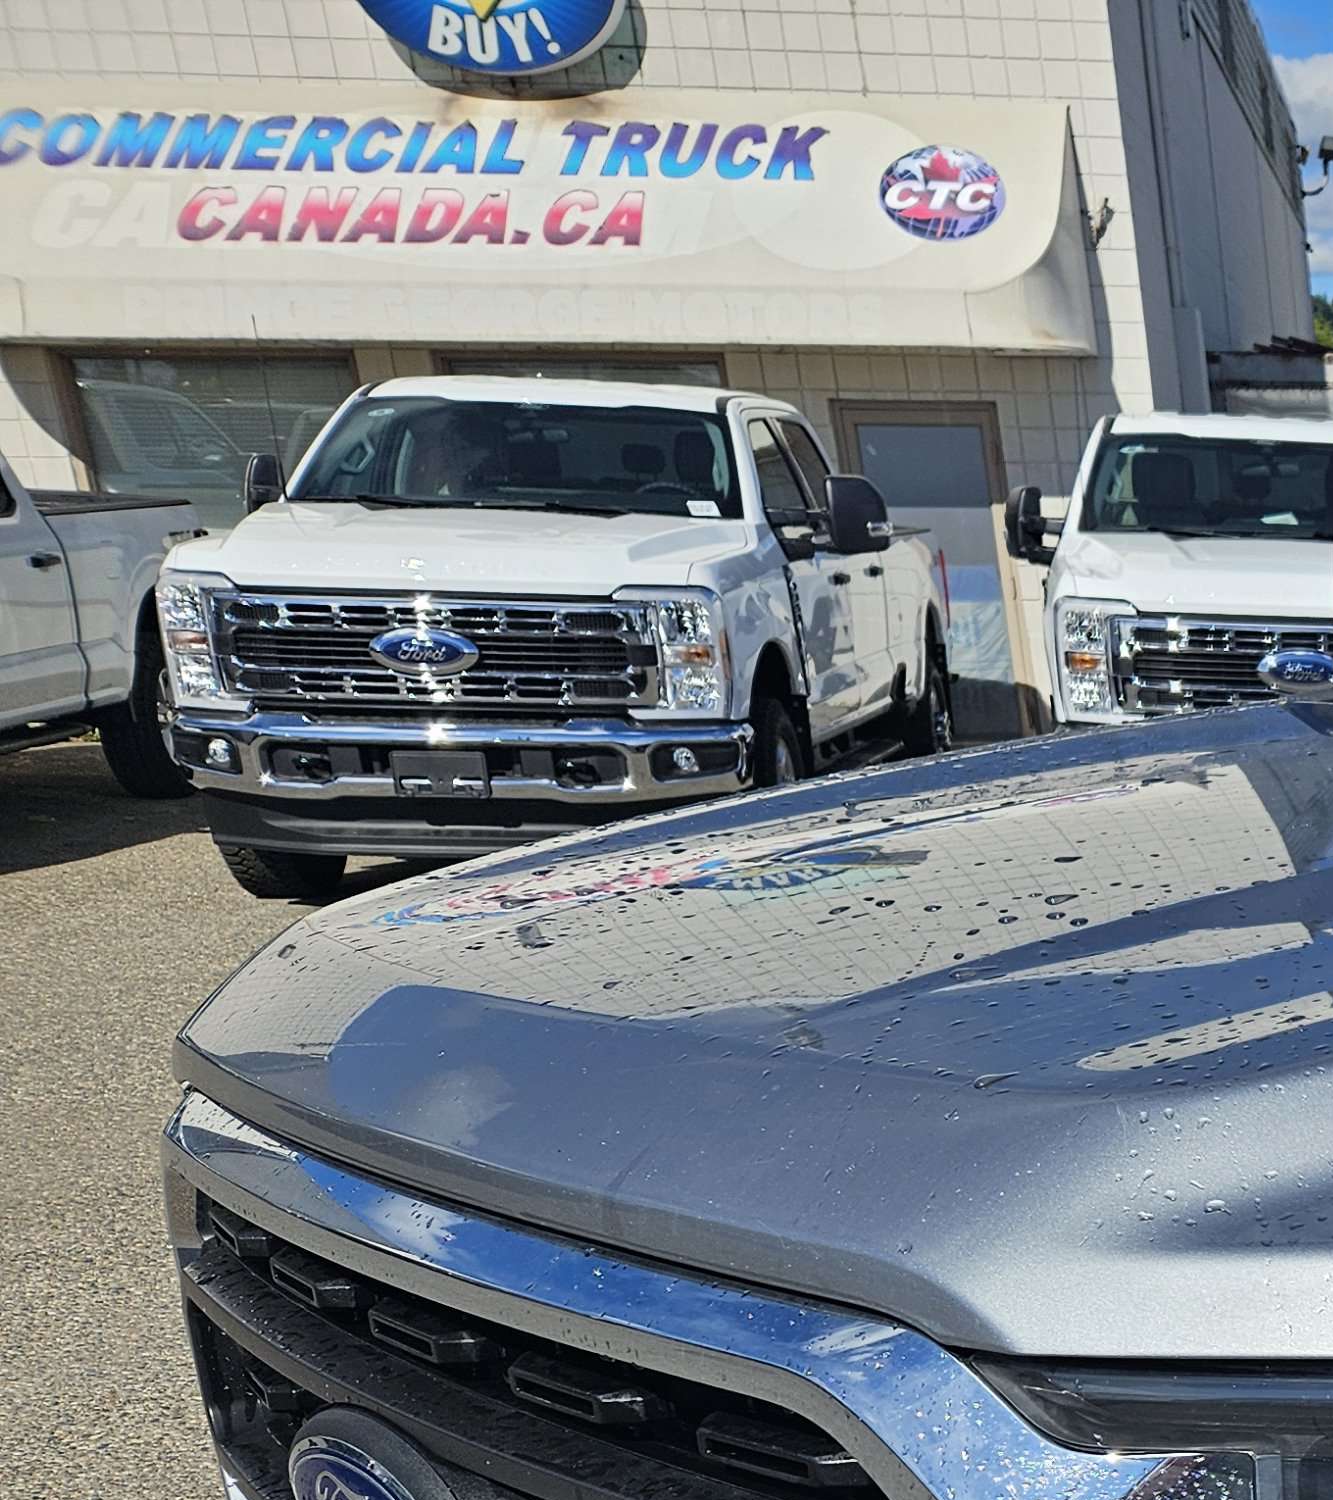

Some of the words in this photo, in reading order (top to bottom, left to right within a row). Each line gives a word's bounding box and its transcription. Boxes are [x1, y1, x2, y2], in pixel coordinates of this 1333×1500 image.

[427, 5, 560, 64] BUY!
[0, 107, 524, 176] COMMERCIAL
[560, 119, 830, 181] TRUCK
[177, 185, 646, 246] CANADA.CA
[884, 180, 996, 212] CTC
[398, 641, 446, 662] Ford
